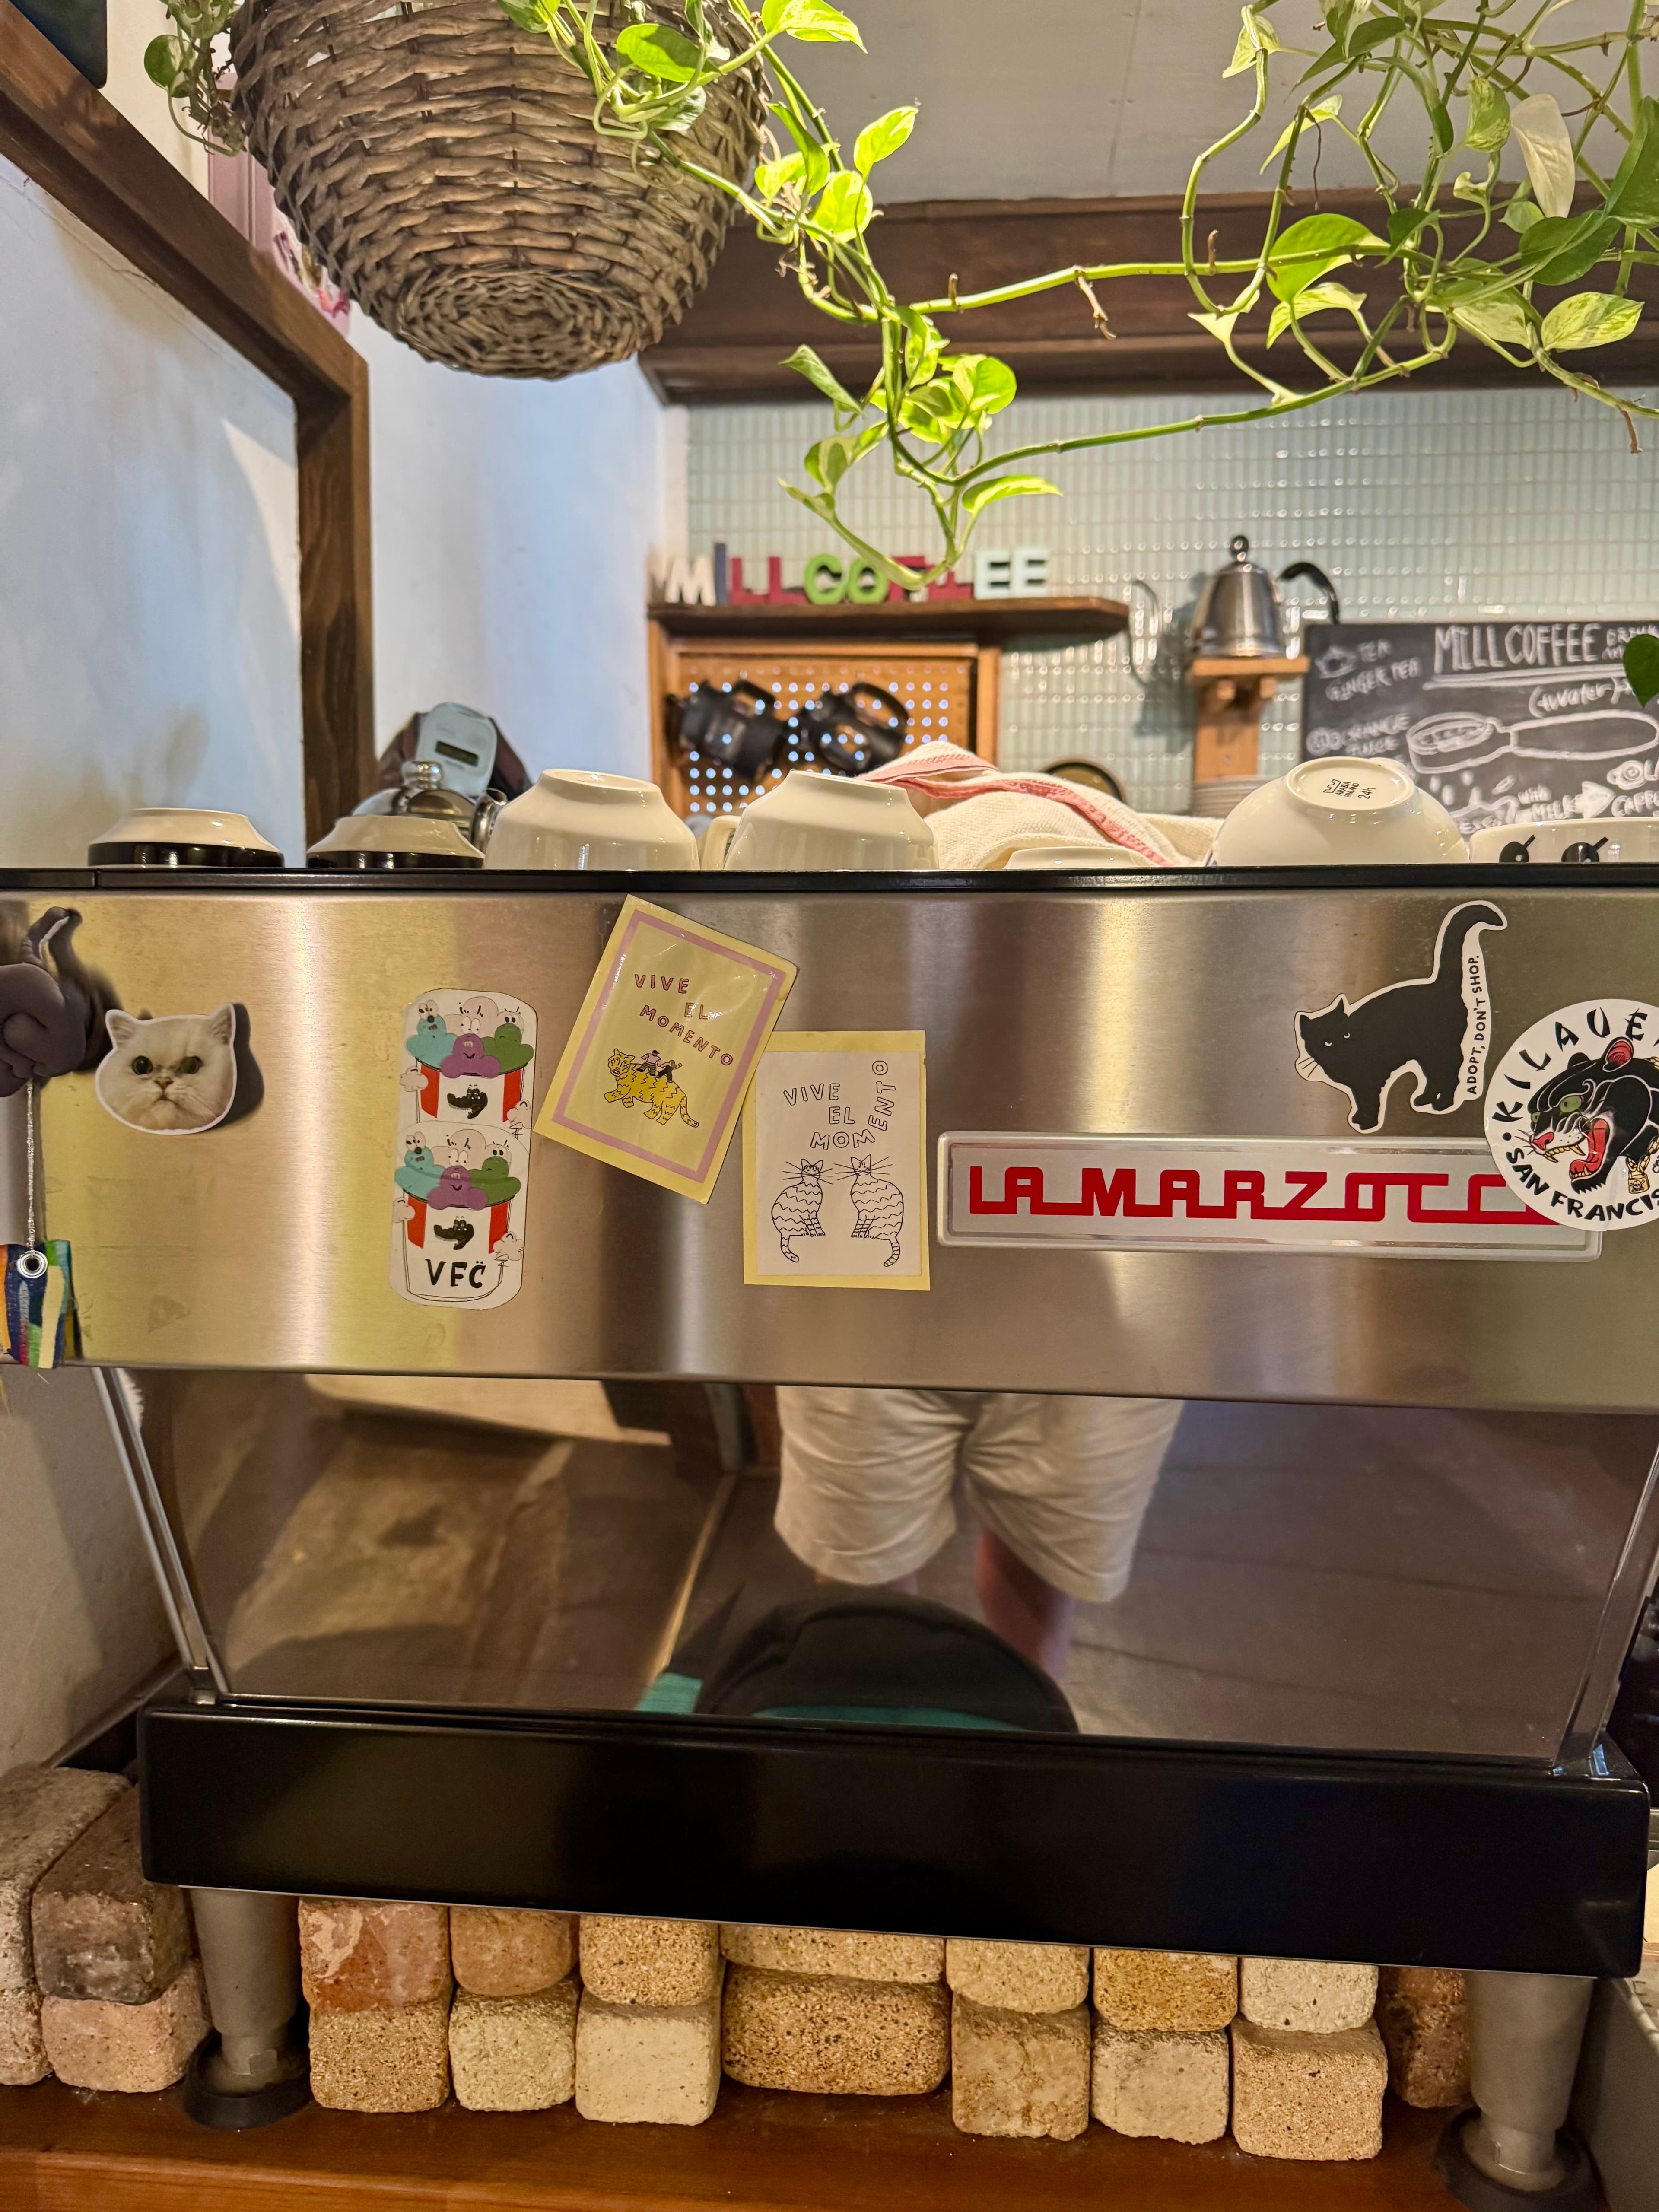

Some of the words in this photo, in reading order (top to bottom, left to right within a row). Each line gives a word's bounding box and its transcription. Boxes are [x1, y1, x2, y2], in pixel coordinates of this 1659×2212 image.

[665, 543, 807, 606] MILL
[1434, 625, 1507, 674] MILL
[1505, 623, 1601, 665] COFFEE
[1357, 787, 1376, 799] 24h
[634, 973, 690, 994] VIVE
[1468, 955, 1482, 994] SHOP.
[639, 1005, 734, 1066] MOMENTO
[684, 1002, 708, 1020] EL
[1473, 998, 1487, 1041] DON'T
[1467, 1046, 1485, 1095] ADOPT,
[1491, 1007, 1659, 1122] KILAUE
[783, 1082, 840, 1106] VIVE
[810, 1060, 896, 1150] MOMENTO
[829, 1106, 855, 1125] EL
[1081, 1167, 1560, 1225] MARZOCC
[1506, 1147, 1550, 1196] SAN
